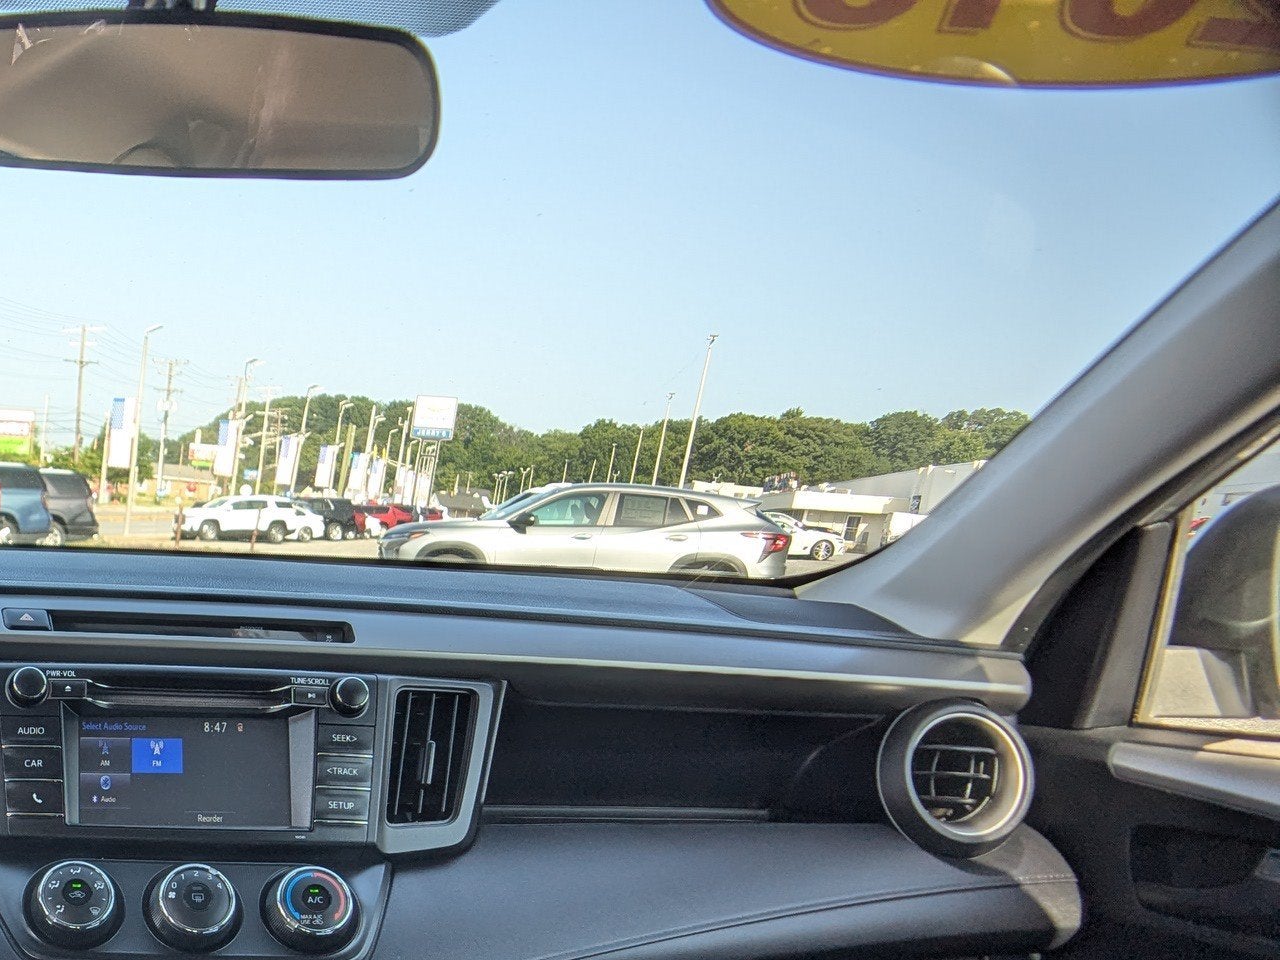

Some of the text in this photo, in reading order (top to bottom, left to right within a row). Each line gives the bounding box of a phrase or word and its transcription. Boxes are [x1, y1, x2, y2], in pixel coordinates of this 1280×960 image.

[17, 726, 45, 735] AUDIO
[82, 722, 147, 731] Select Audio Source
[203, 722, 227, 733] 8:47
[24, 759, 43, 767] CAR
[328, 800, 355, 810] SETUP
[197, 814, 223, 823] Reorder
[307, 896, 324, 904] A/C
